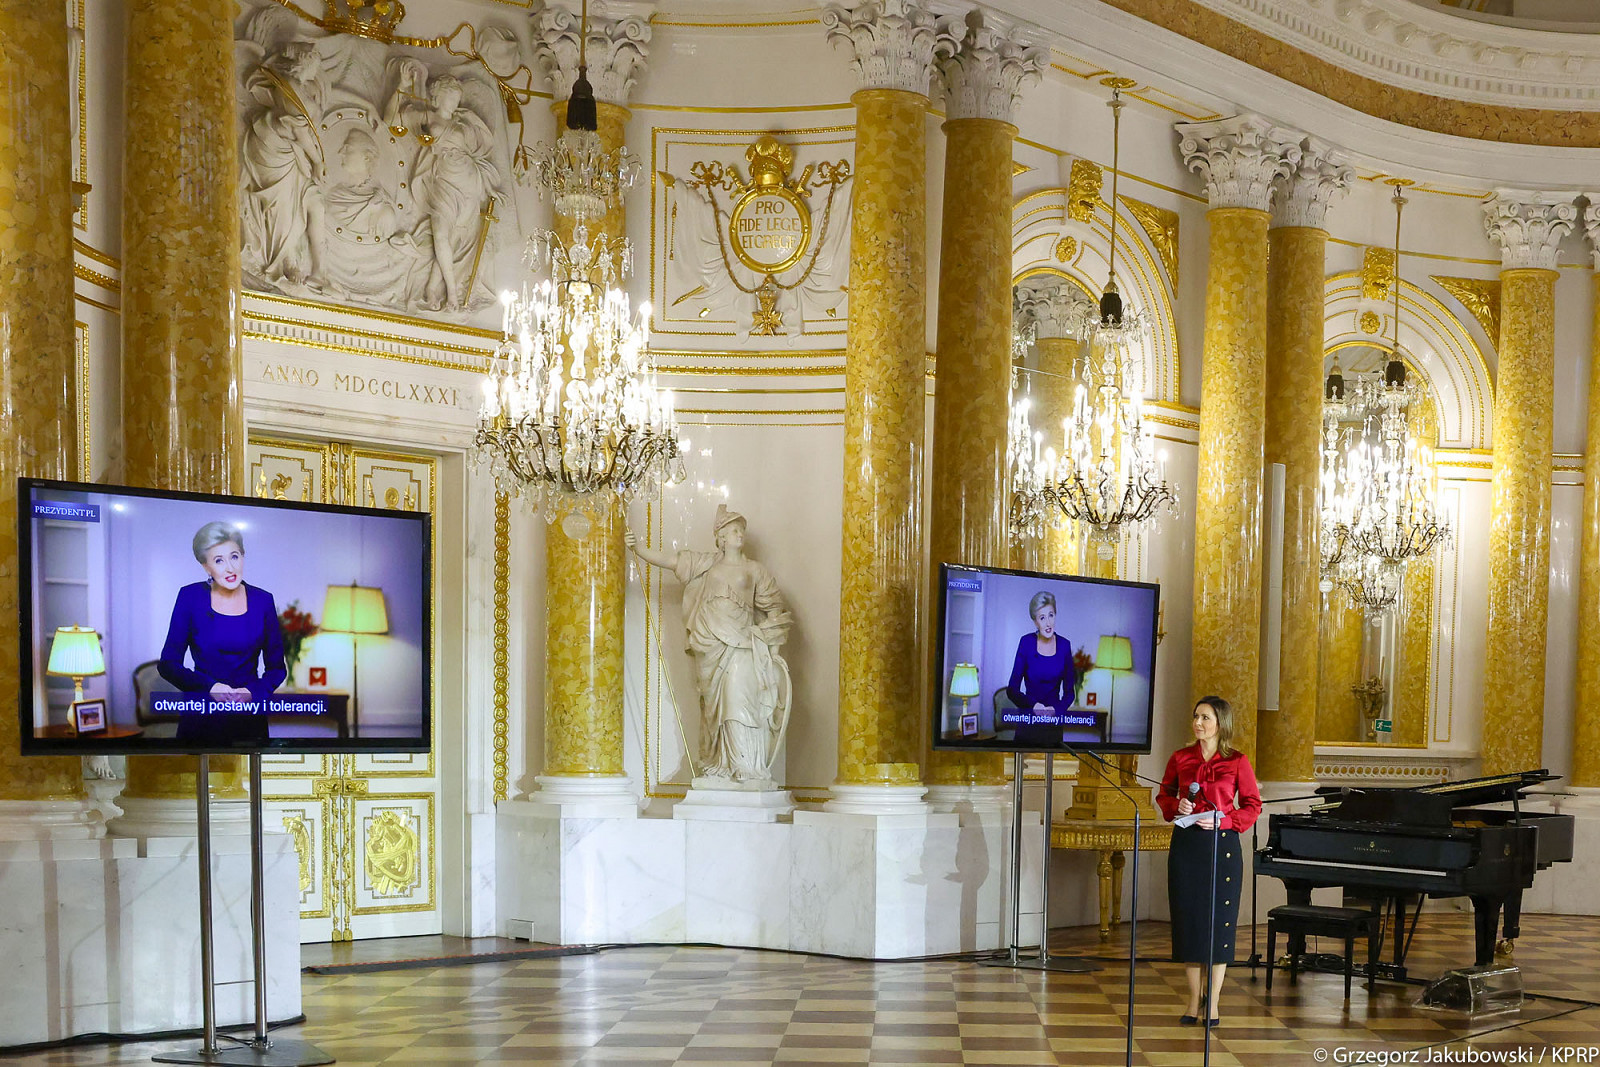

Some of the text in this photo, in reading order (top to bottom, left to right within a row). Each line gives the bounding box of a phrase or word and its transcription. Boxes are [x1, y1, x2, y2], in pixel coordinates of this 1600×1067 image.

[755, 201, 785, 215] PRO
[739, 218, 800, 232] FIDE LEGE
[742, 235, 753, 249] ET
[262, 364, 457, 406] ANNO MDCCLXXXI
[154, 699, 327, 716] otwartej postawy i tolerancji.
[1003, 714, 1031, 724] otwartej
[1032, 716, 1060, 726] postawy
[1064, 716, 1096, 726] tolerancji.
